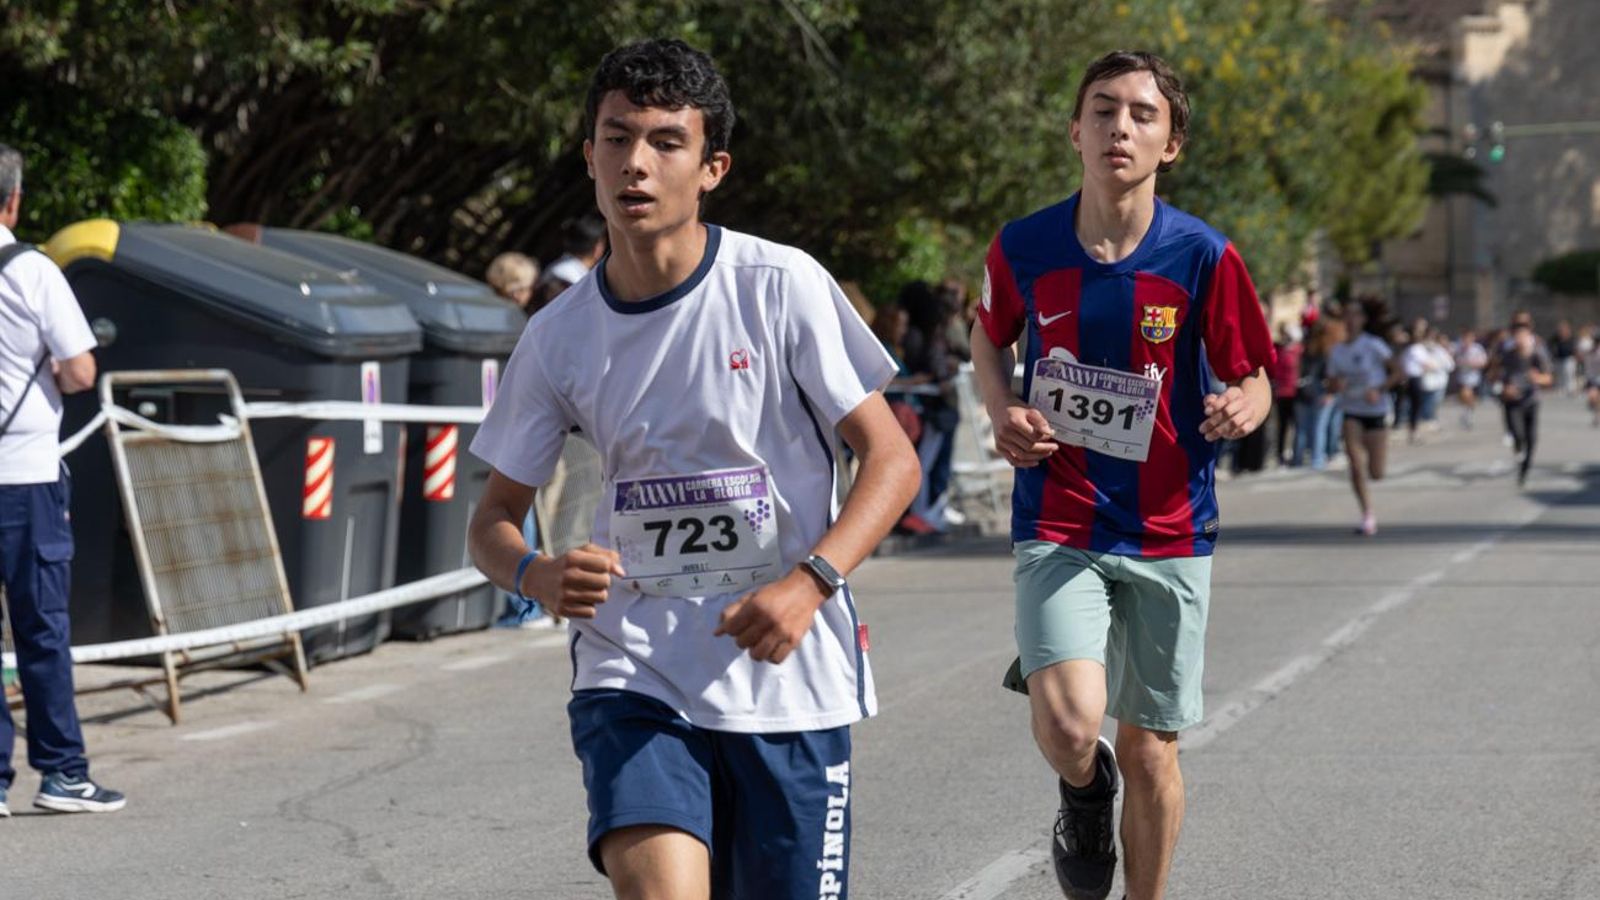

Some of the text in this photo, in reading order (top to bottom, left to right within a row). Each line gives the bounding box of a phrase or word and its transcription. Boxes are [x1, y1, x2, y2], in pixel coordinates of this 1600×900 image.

[1144, 362, 1169, 381] ify
[1103, 380, 1112, 389] LA
[1118, 385, 1145, 395] GLORIA
[1127, 377, 1156, 389] ESCOLAR
[1048, 387, 1136, 430] 1391
[685, 472, 762, 491] CARRERA ESCOLAR
[694, 484, 752, 502] LA GLORIA
[643, 514, 739, 557] 723
[817, 760, 850, 900] PÍNOLA
